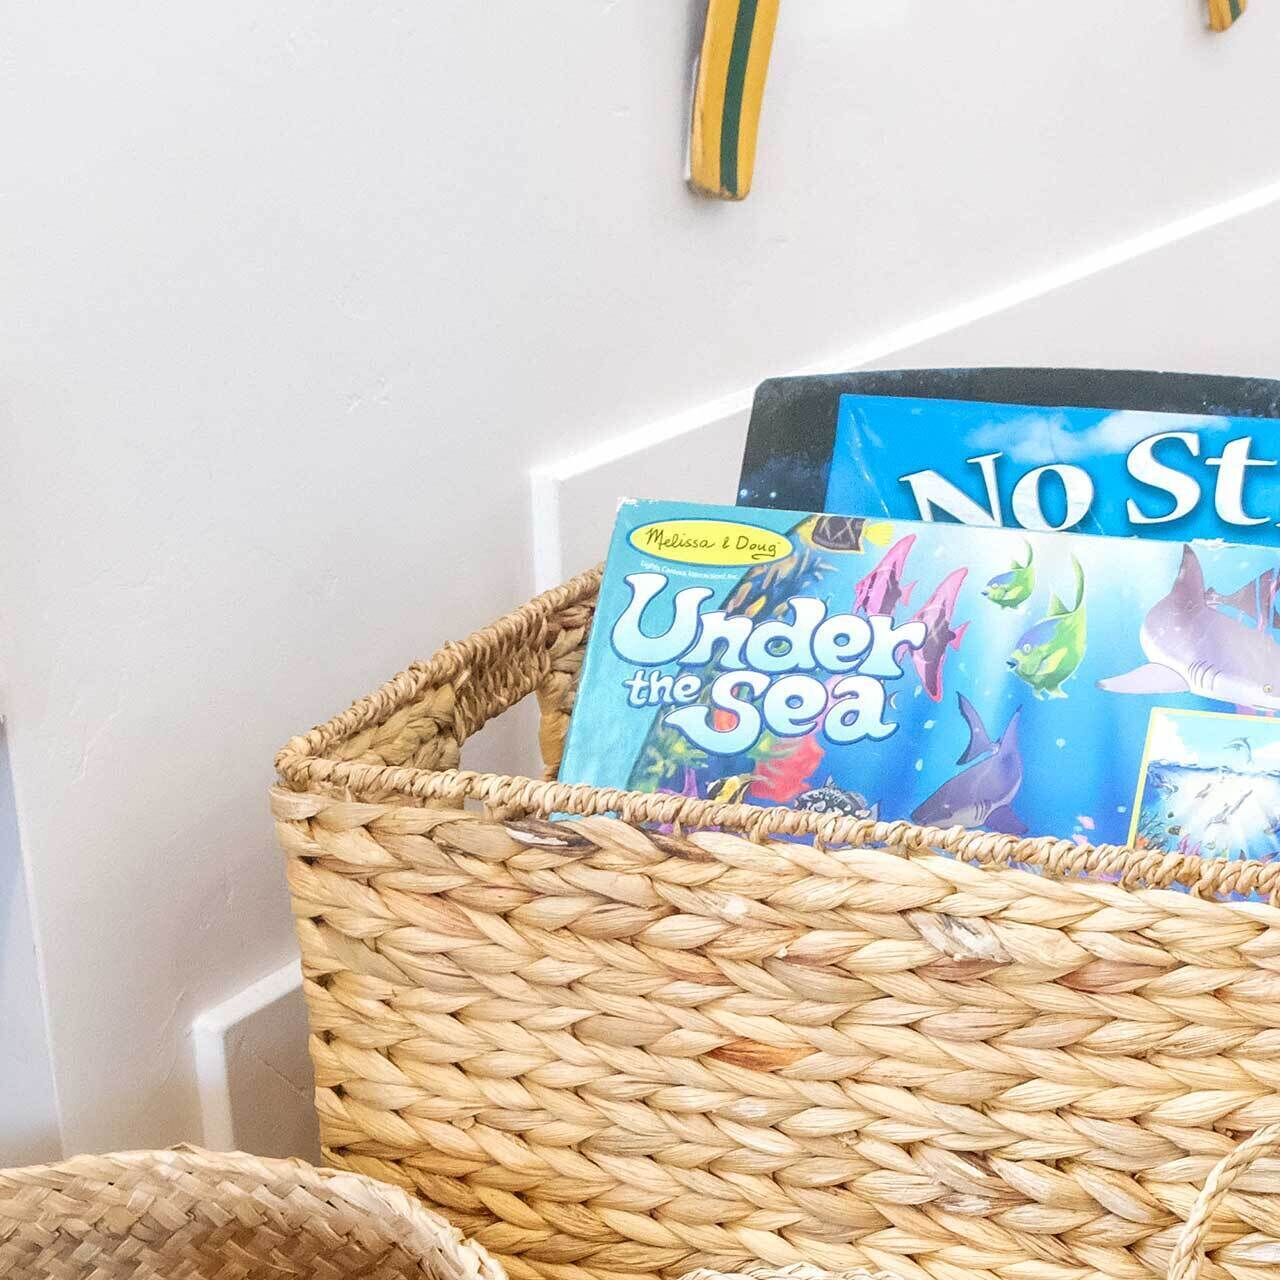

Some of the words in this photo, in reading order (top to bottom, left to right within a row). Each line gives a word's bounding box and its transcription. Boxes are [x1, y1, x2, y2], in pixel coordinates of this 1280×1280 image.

[899, 451, 1095, 533] No
[645, 527, 716, 551] Melissa
[735, 535, 778, 560] Doug
[610, 571, 928, 681] Under
[622, 669, 702, 709] the
[662, 669, 900, 757] Sea
